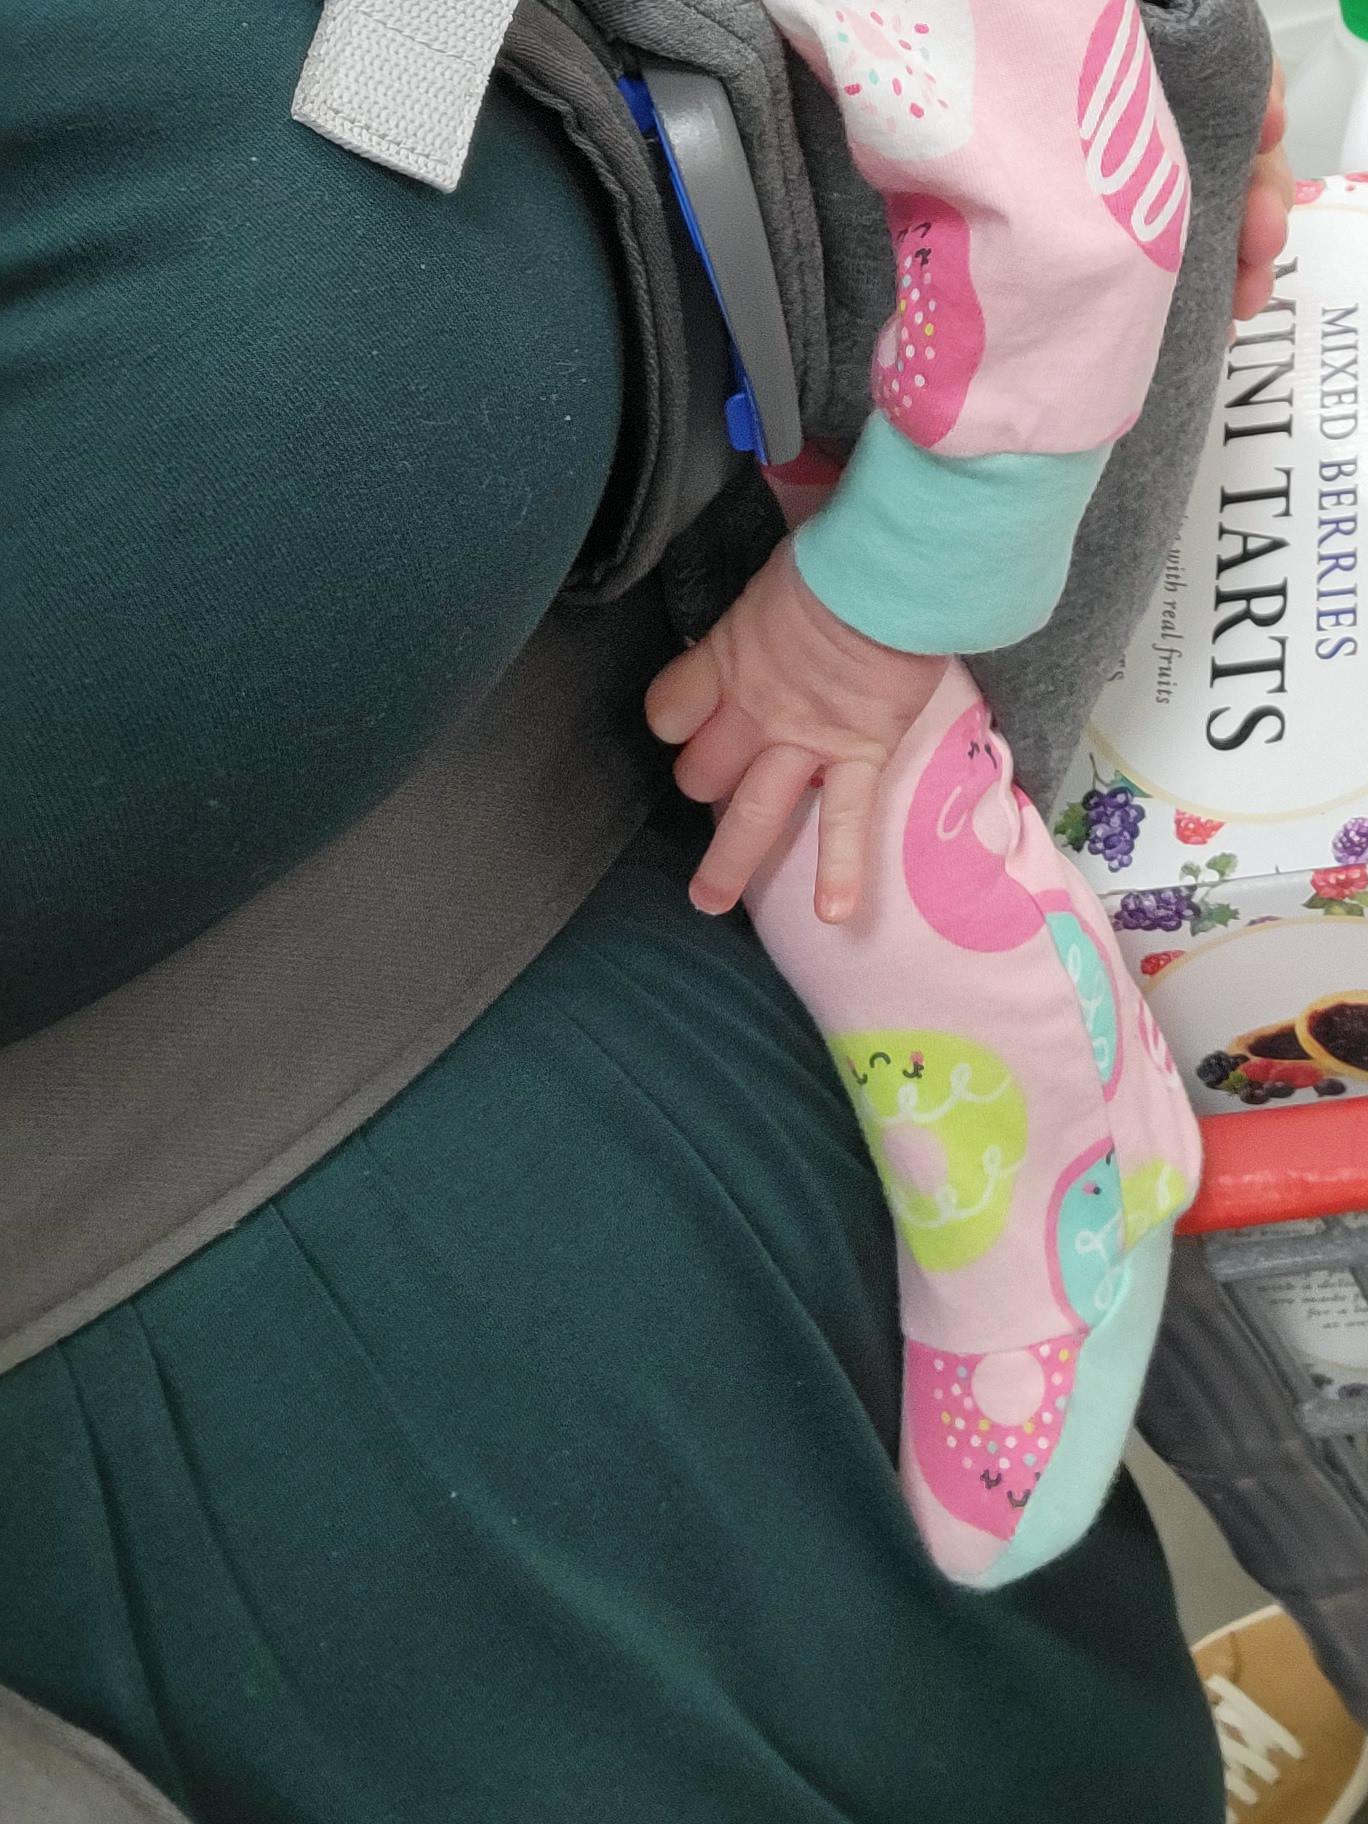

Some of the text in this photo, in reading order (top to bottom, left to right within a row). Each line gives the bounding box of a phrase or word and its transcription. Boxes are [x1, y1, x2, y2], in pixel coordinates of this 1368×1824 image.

[1314, 302, 1361, 662] MIXED BERRIES
[1164, 549, 1188, 593] with
[1161, 598, 1185, 641] real
[1205, 466, 1296, 756] TARTS
[1151, 642, 1183, 705] fruits
